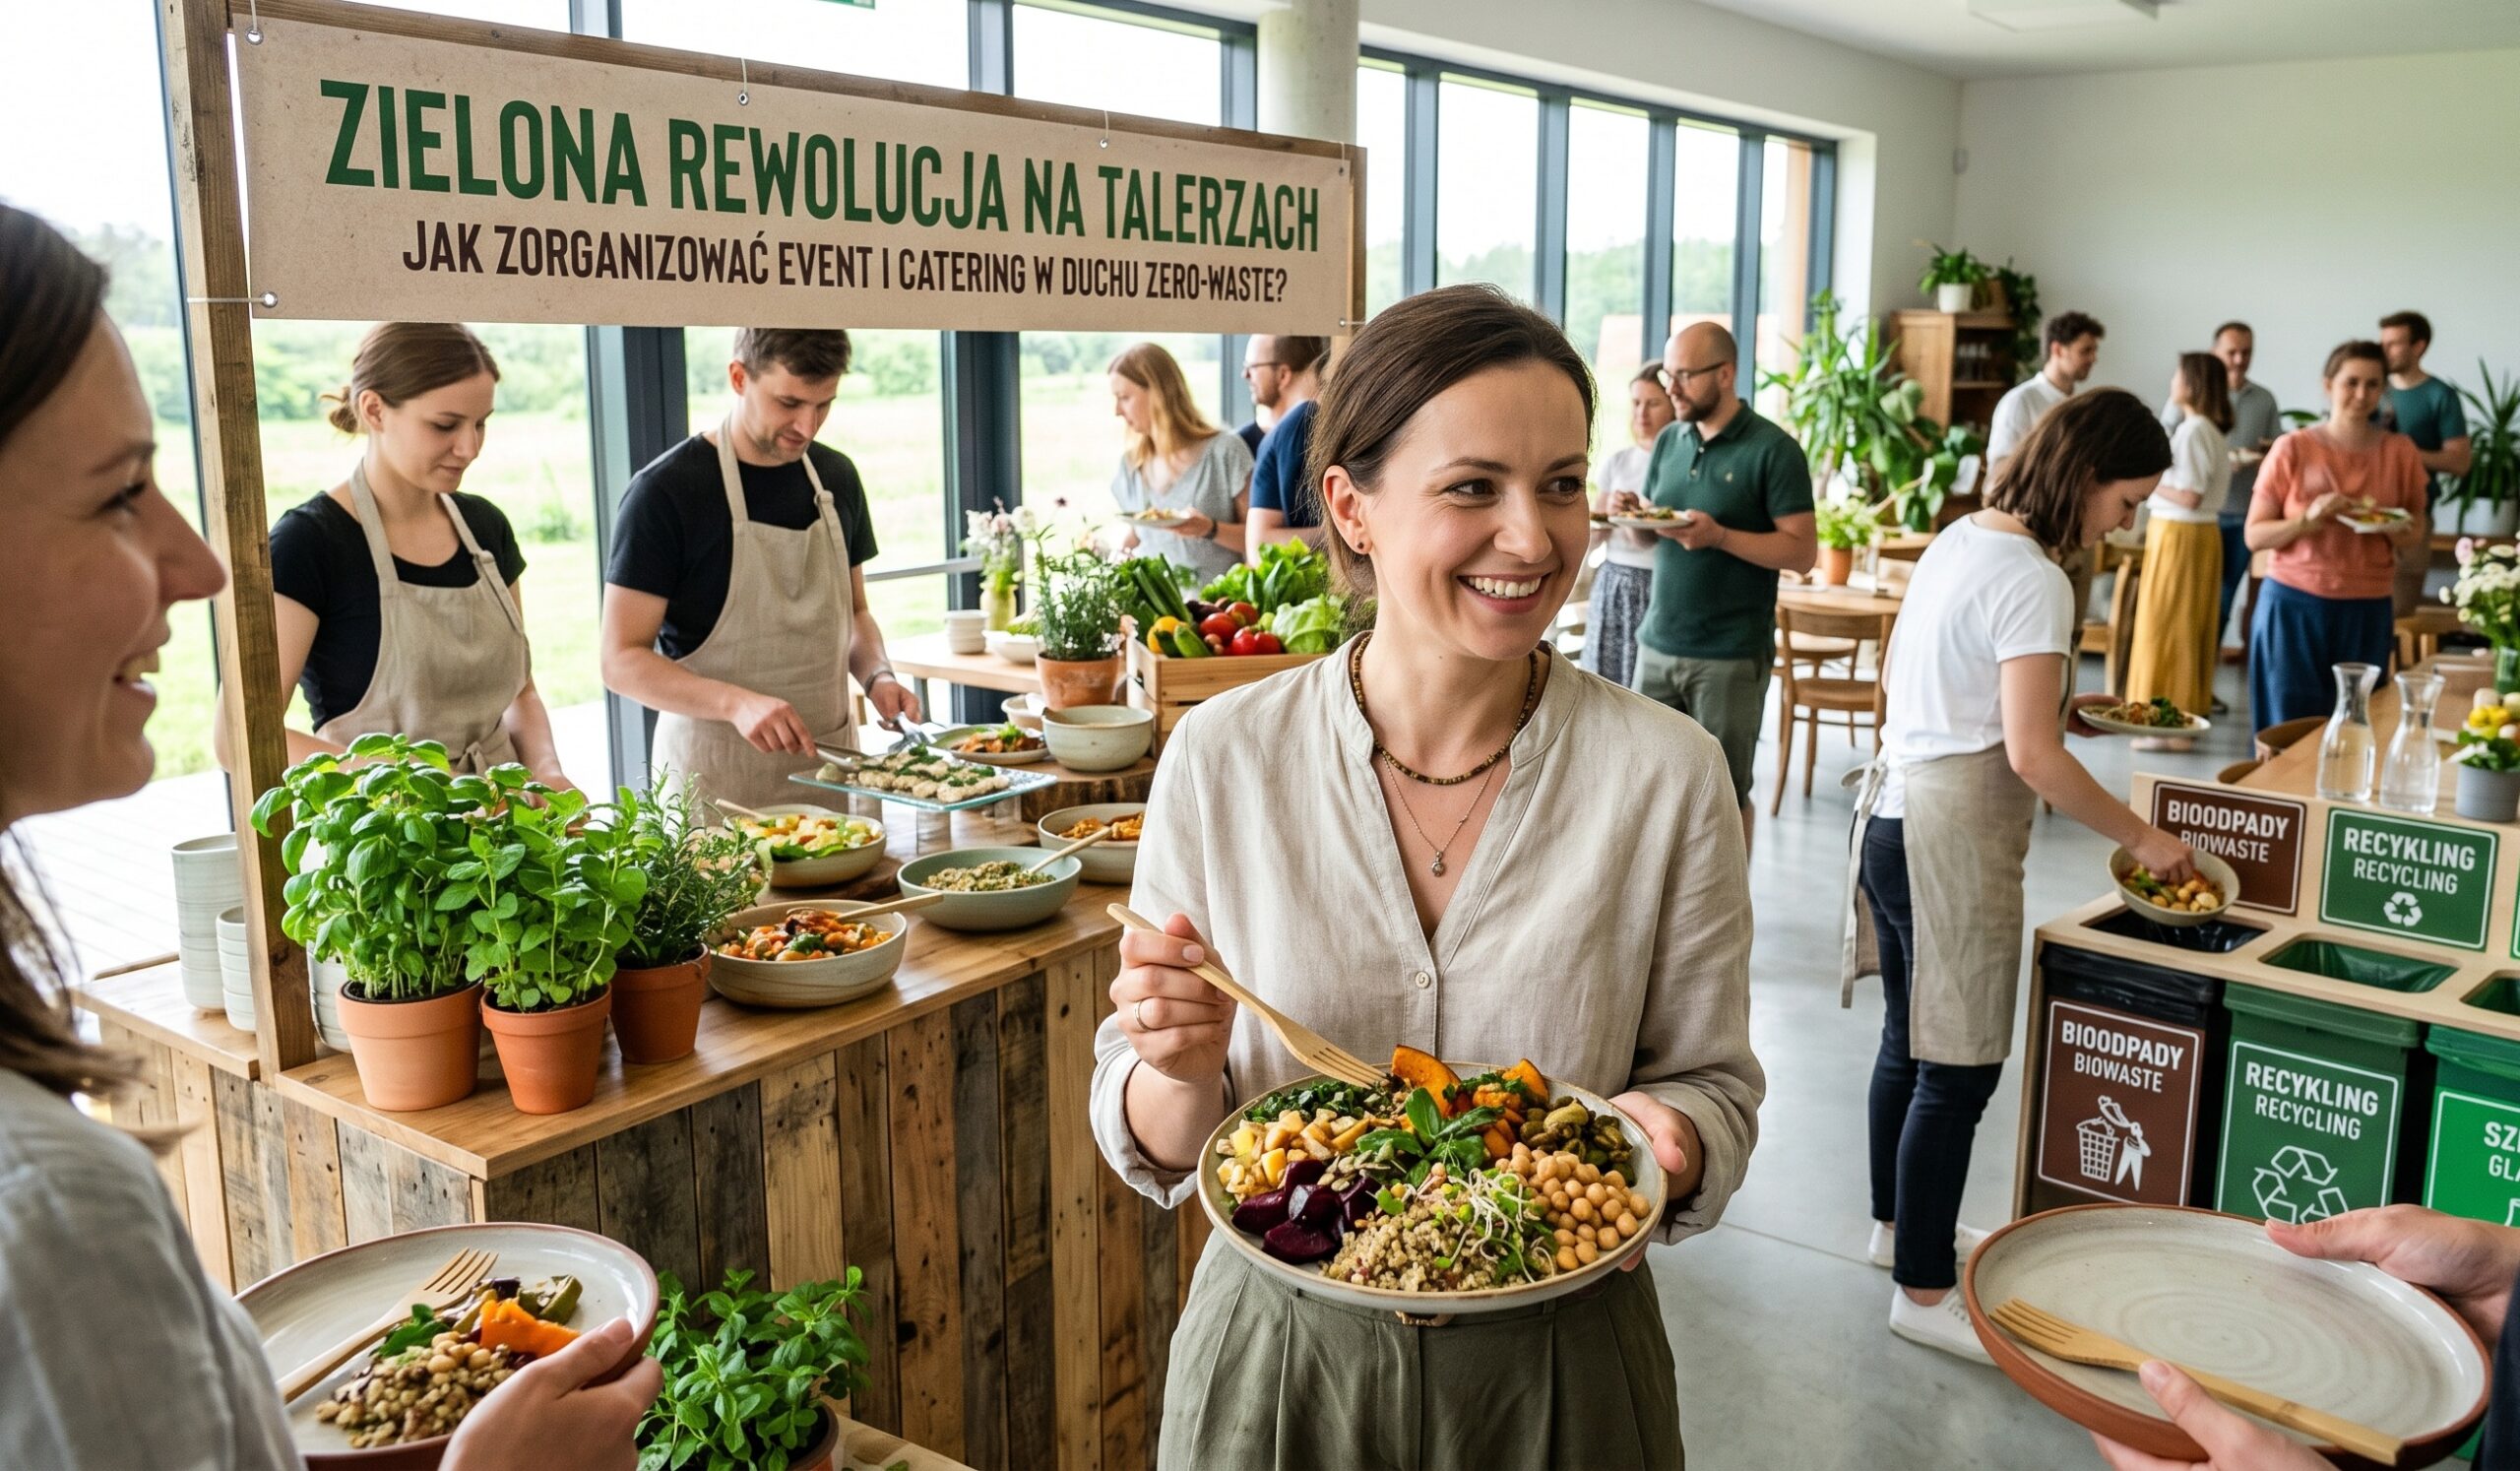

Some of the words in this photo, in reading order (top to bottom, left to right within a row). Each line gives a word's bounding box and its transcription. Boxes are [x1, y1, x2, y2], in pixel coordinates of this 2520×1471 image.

[320, 79, 649, 207] ZIELONA
[668, 118, 1009, 232] REWOLUCJA
[1024, 159, 1086, 237] NA
[1098, 165, 1319, 253] TALERZACH
[402, 220, 484, 274] JAK
[493, 225, 769, 286] ZORGANIZOWAĆ
[778, 241, 873, 288] EVENT
[882, 247, 890, 289] I
[899, 248, 1026, 294] CATERING
[1033, 255, 1054, 295] W
[1062, 256, 1139, 298] DUCHU
[1145, 261, 1288, 304] ZERO-WASTE?
[2167, 799, 2290, 840] BIOODPADY
[2180, 830, 2270, 863] BIOWASTE
[2343, 827, 2476, 871] RECYKLING
[2353, 858, 2458, 895] RECYCLING
[2061, 1020, 2184, 1071] BIOODPADY
[2074, 1052, 2164, 1094] BIOWASTE
[2245, 1061, 2379, 1117] RECYKLING
[2254, 1093, 2362, 1140] RECYCLING
[2484, 1120, 2520, 1153] SZ
